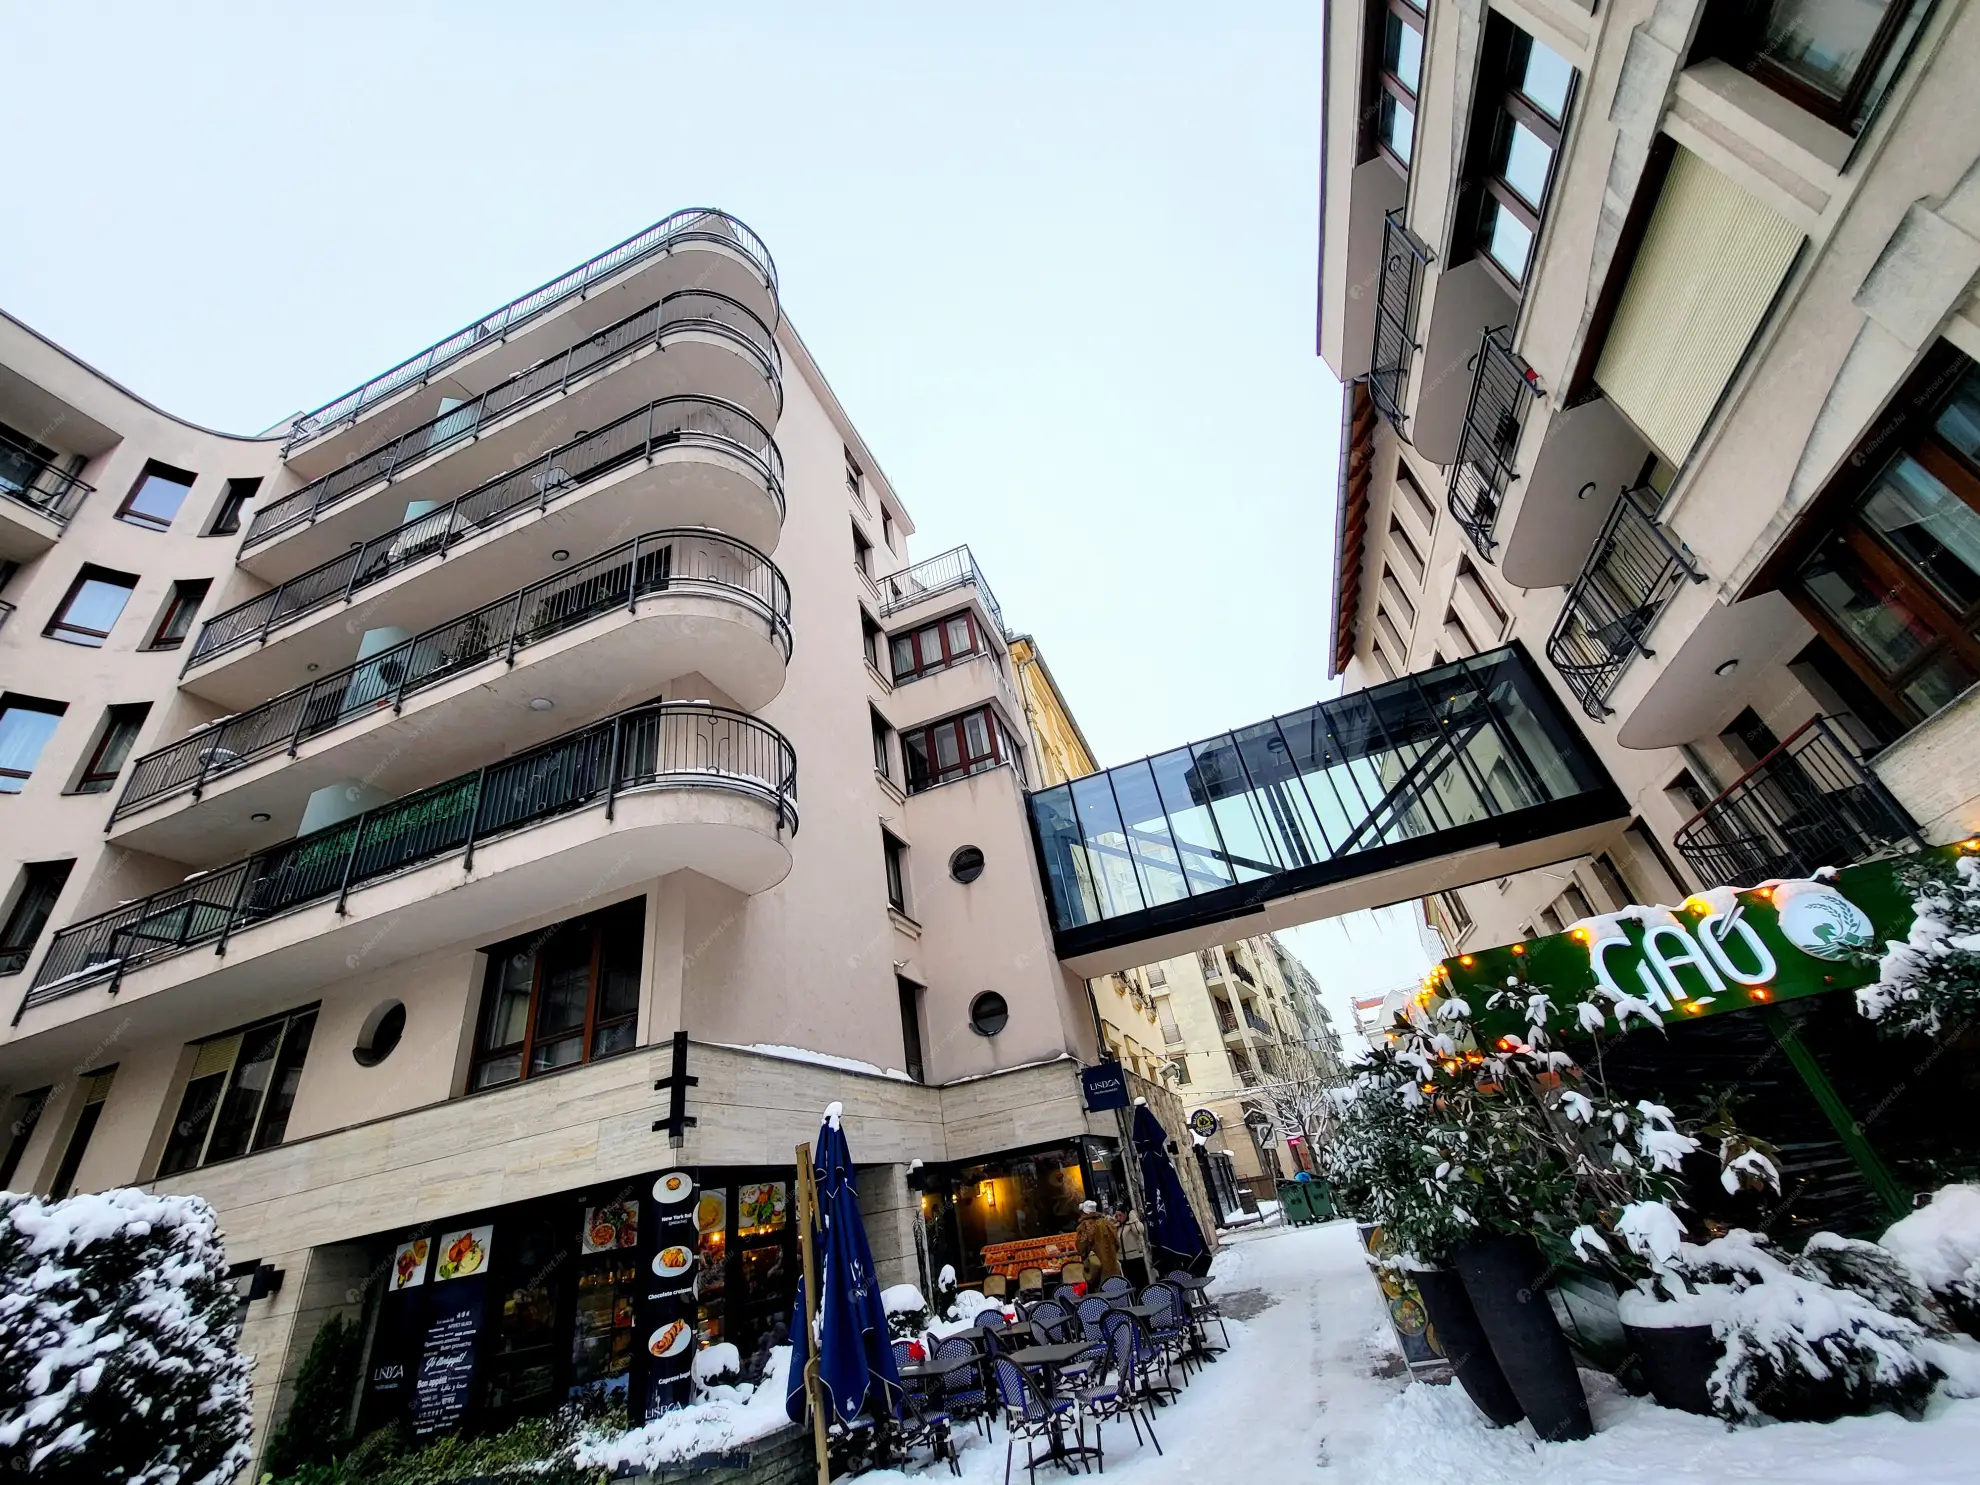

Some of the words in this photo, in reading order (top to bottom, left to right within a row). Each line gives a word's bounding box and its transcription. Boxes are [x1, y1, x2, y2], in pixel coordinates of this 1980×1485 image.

[1089, 1078, 1121, 1091] LISBOA
[647, 1291, 673, 1300] Chocolate
[373, 1364, 404, 1381] LISBOA
[416, 1379, 429, 1389] Bon
[644, 1401, 682, 1419] LISBOA
